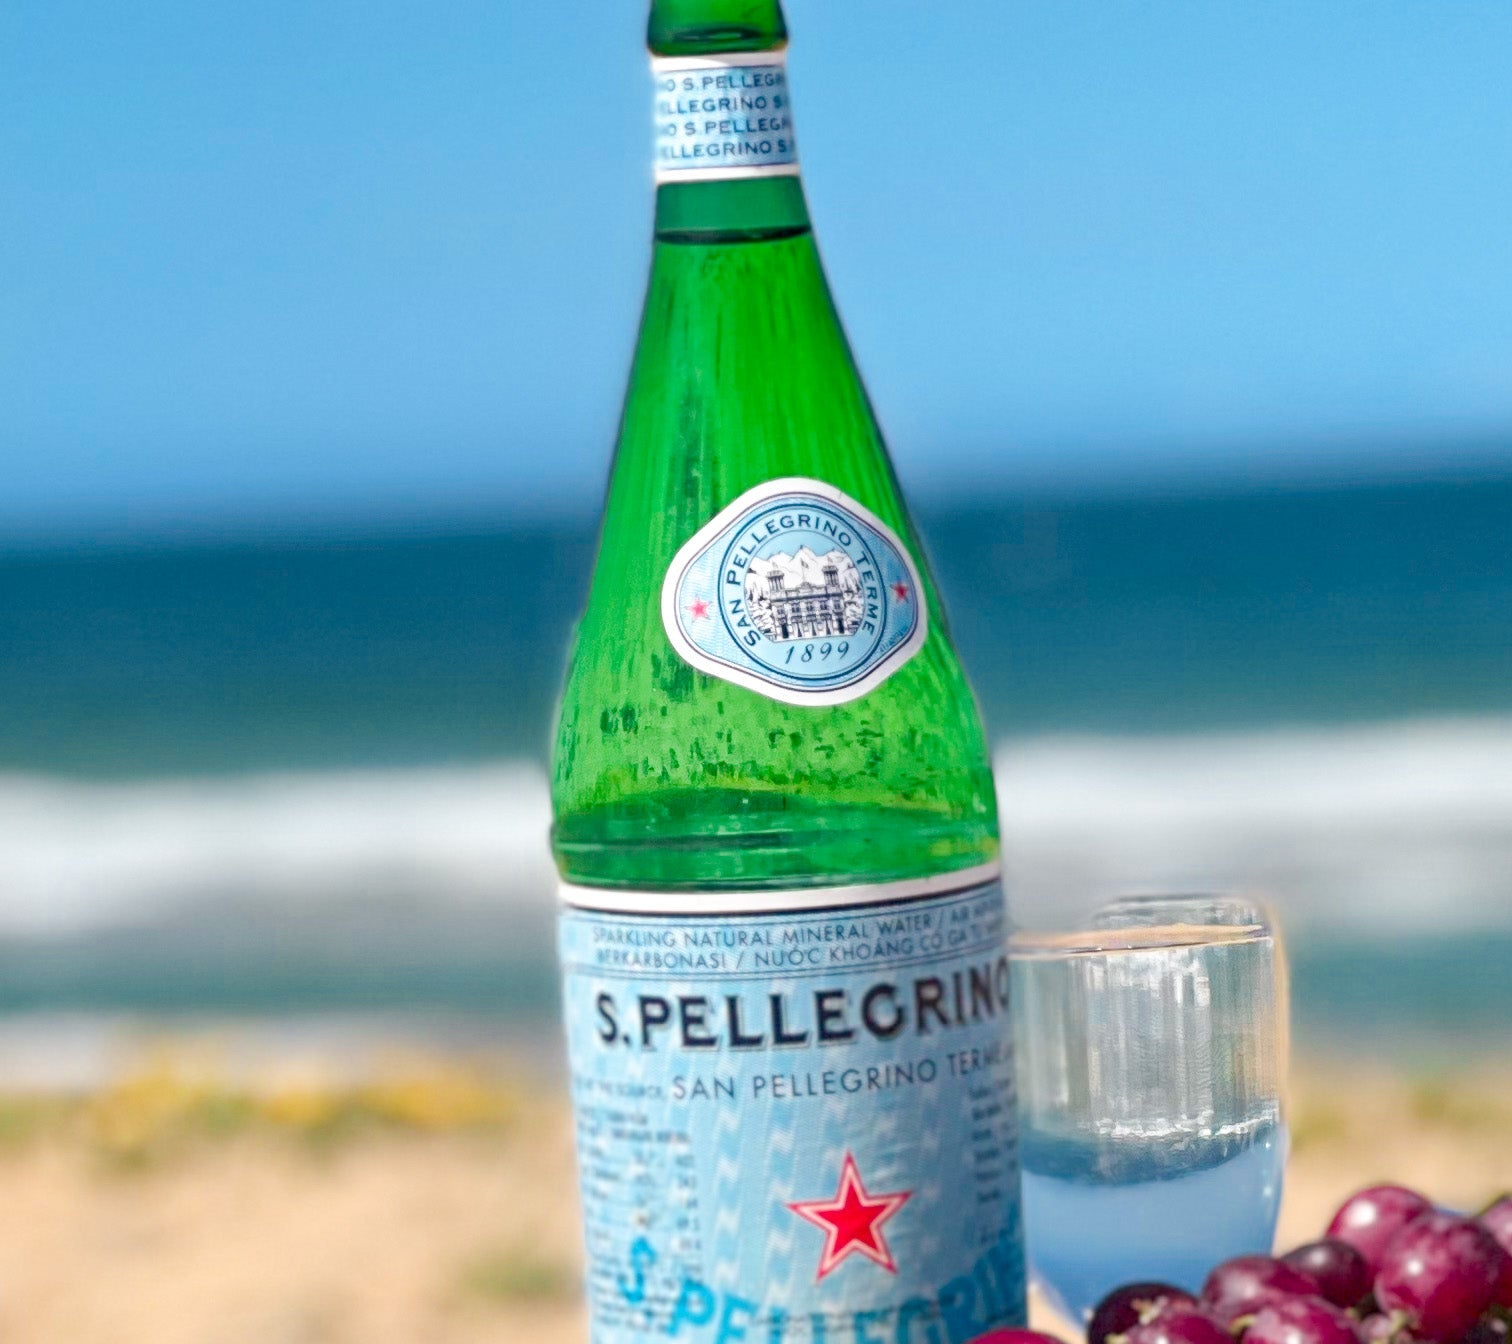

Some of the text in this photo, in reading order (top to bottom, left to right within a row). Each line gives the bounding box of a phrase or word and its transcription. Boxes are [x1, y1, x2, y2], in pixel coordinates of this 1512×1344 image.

[727, 514, 878, 647] SAN PELLEGRINO TERME
[785, 641, 850, 664] 1899
[592, 926, 676, 947] SPARKLING
[684, 930, 773, 947] NATURAL
[783, 924, 868, 944] MINERAL
[875, 914, 931, 935] WATER
[672, 1075, 735, 1100] SAN
[753, 1058, 936, 1099] PELLEGRINO
